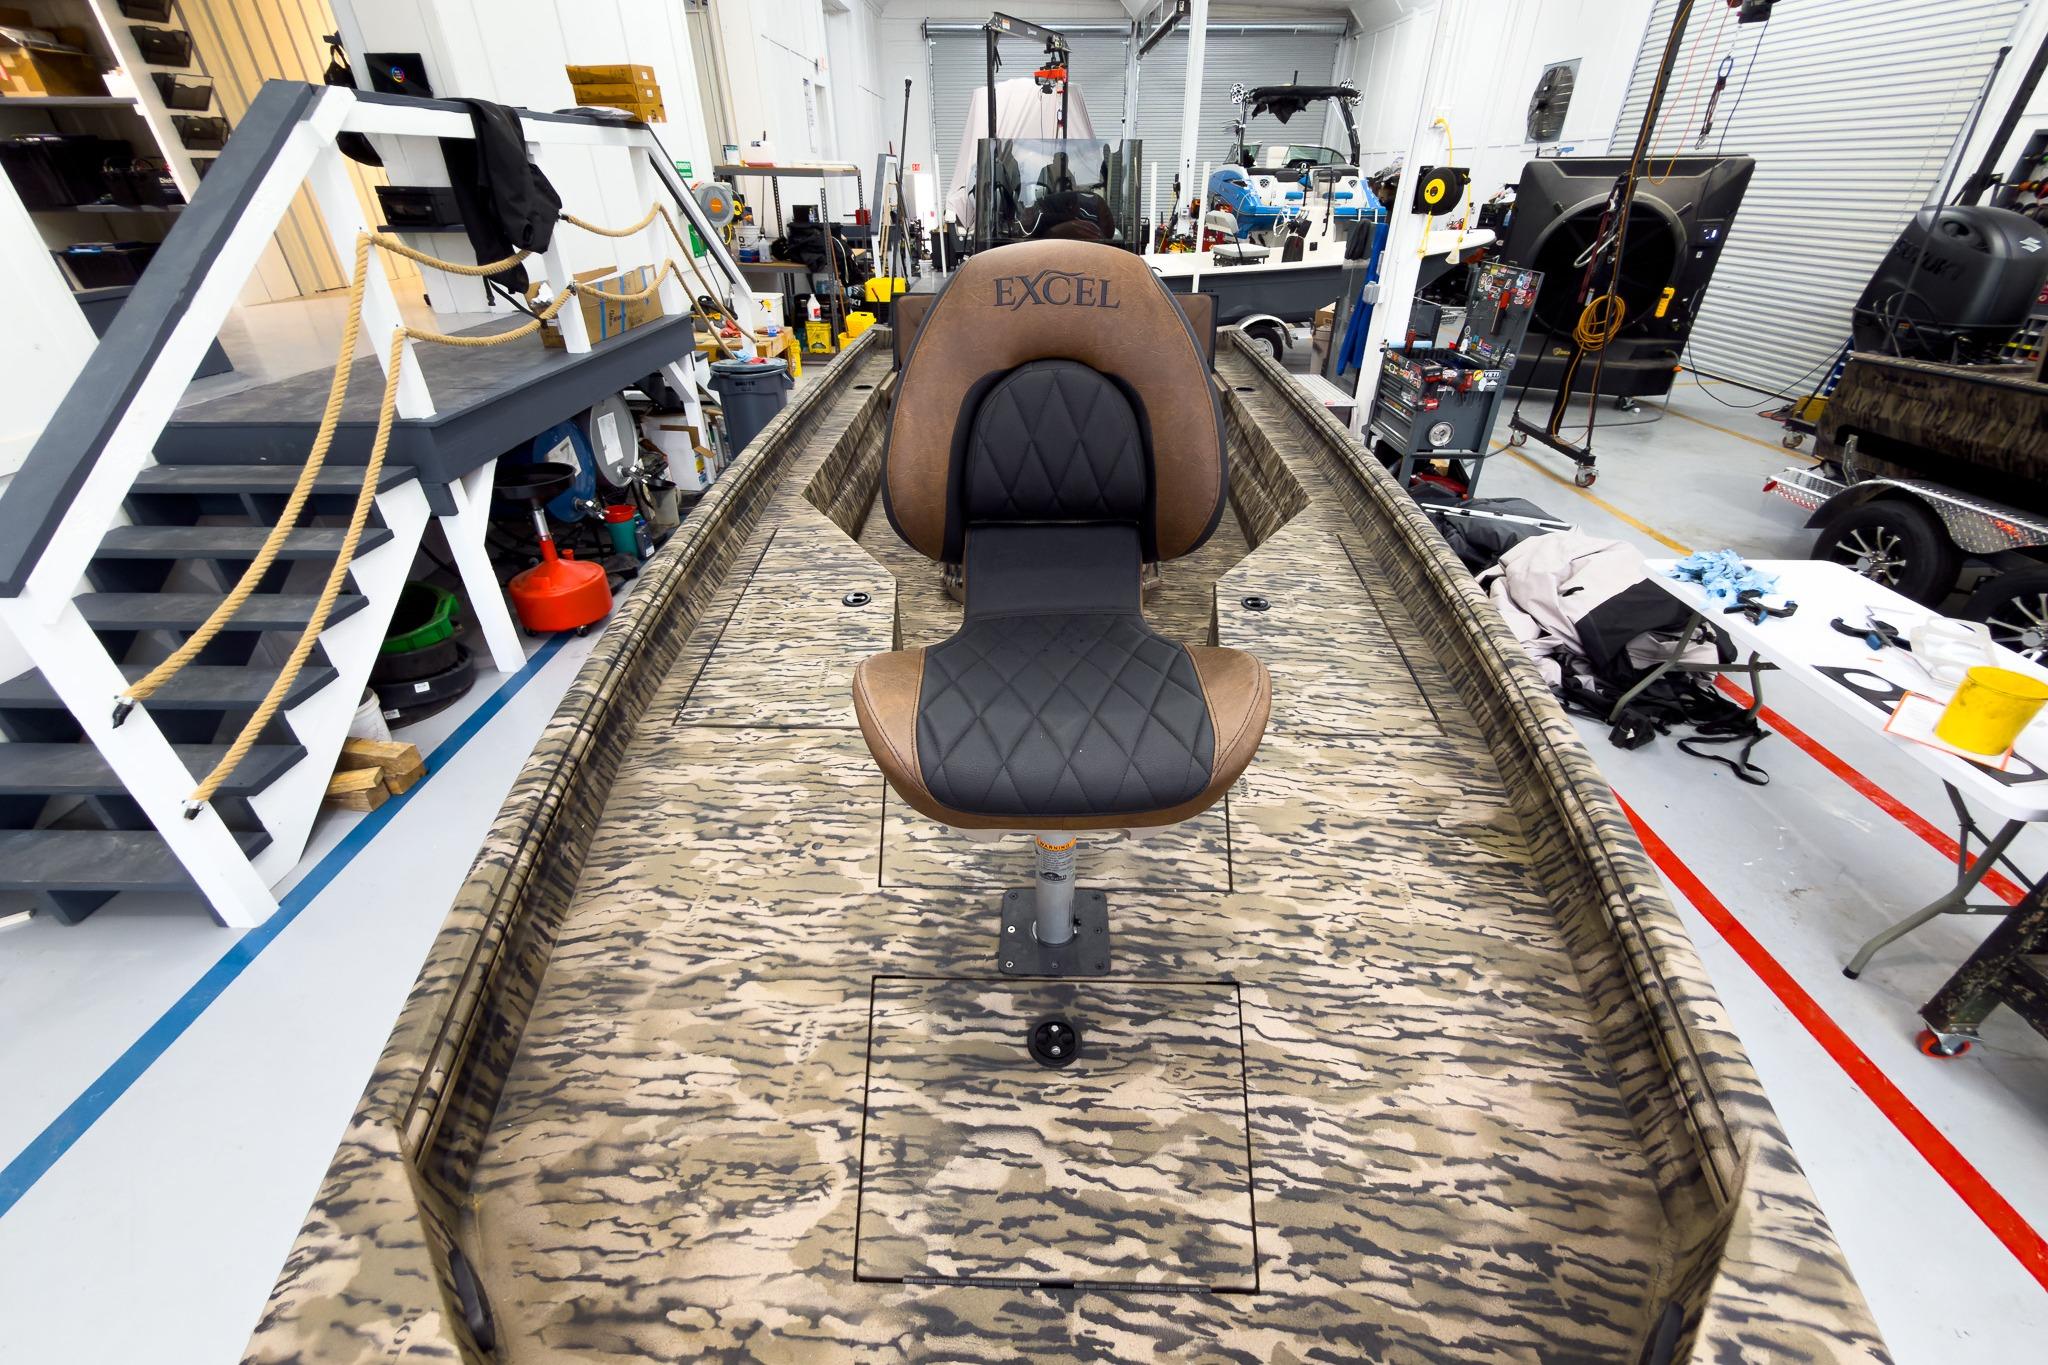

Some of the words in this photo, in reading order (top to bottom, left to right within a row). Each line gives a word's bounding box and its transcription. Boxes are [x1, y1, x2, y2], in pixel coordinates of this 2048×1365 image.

[992, 269, 1120, 311] EXCEL
[1040, 841, 1070, 850] WARNING
[798, 1019, 818, 1065] MOSSY
